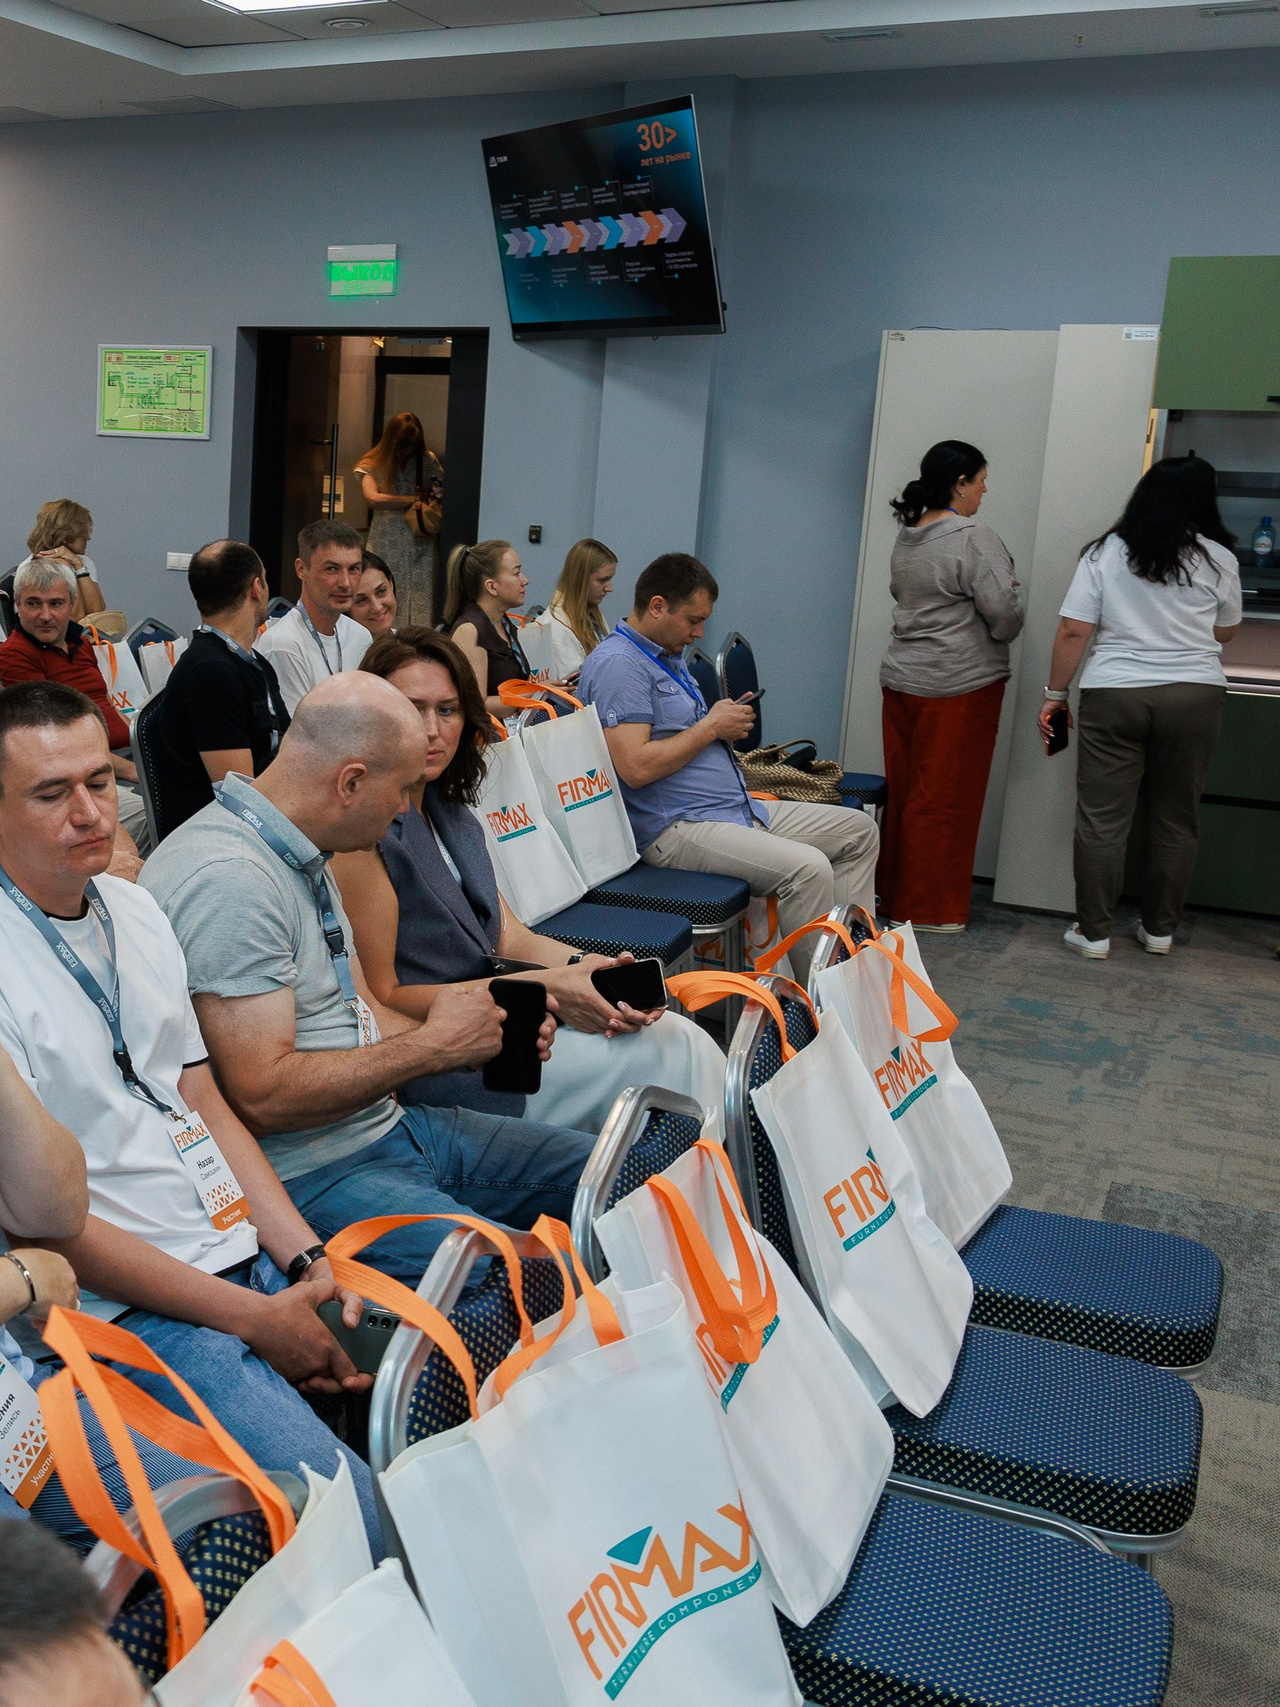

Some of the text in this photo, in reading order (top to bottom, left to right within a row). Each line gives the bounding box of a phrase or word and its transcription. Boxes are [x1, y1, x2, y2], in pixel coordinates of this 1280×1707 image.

[331, 264, 394, 282] ВЫХОД
[557, 767, 612, 806] FIRMA
[486, 803, 534, 836] FIRMAX
[874, 1041, 934, 1109] FIRMAX
[174, 1122, 208, 1149] FIRMAX
[196, 1156, 215, 1170] Назар
[823, 1160, 889, 1238] FIR
[30, 1452, 54, 1487] Участн
[611, 1630, 655, 1689] FURNITURE
